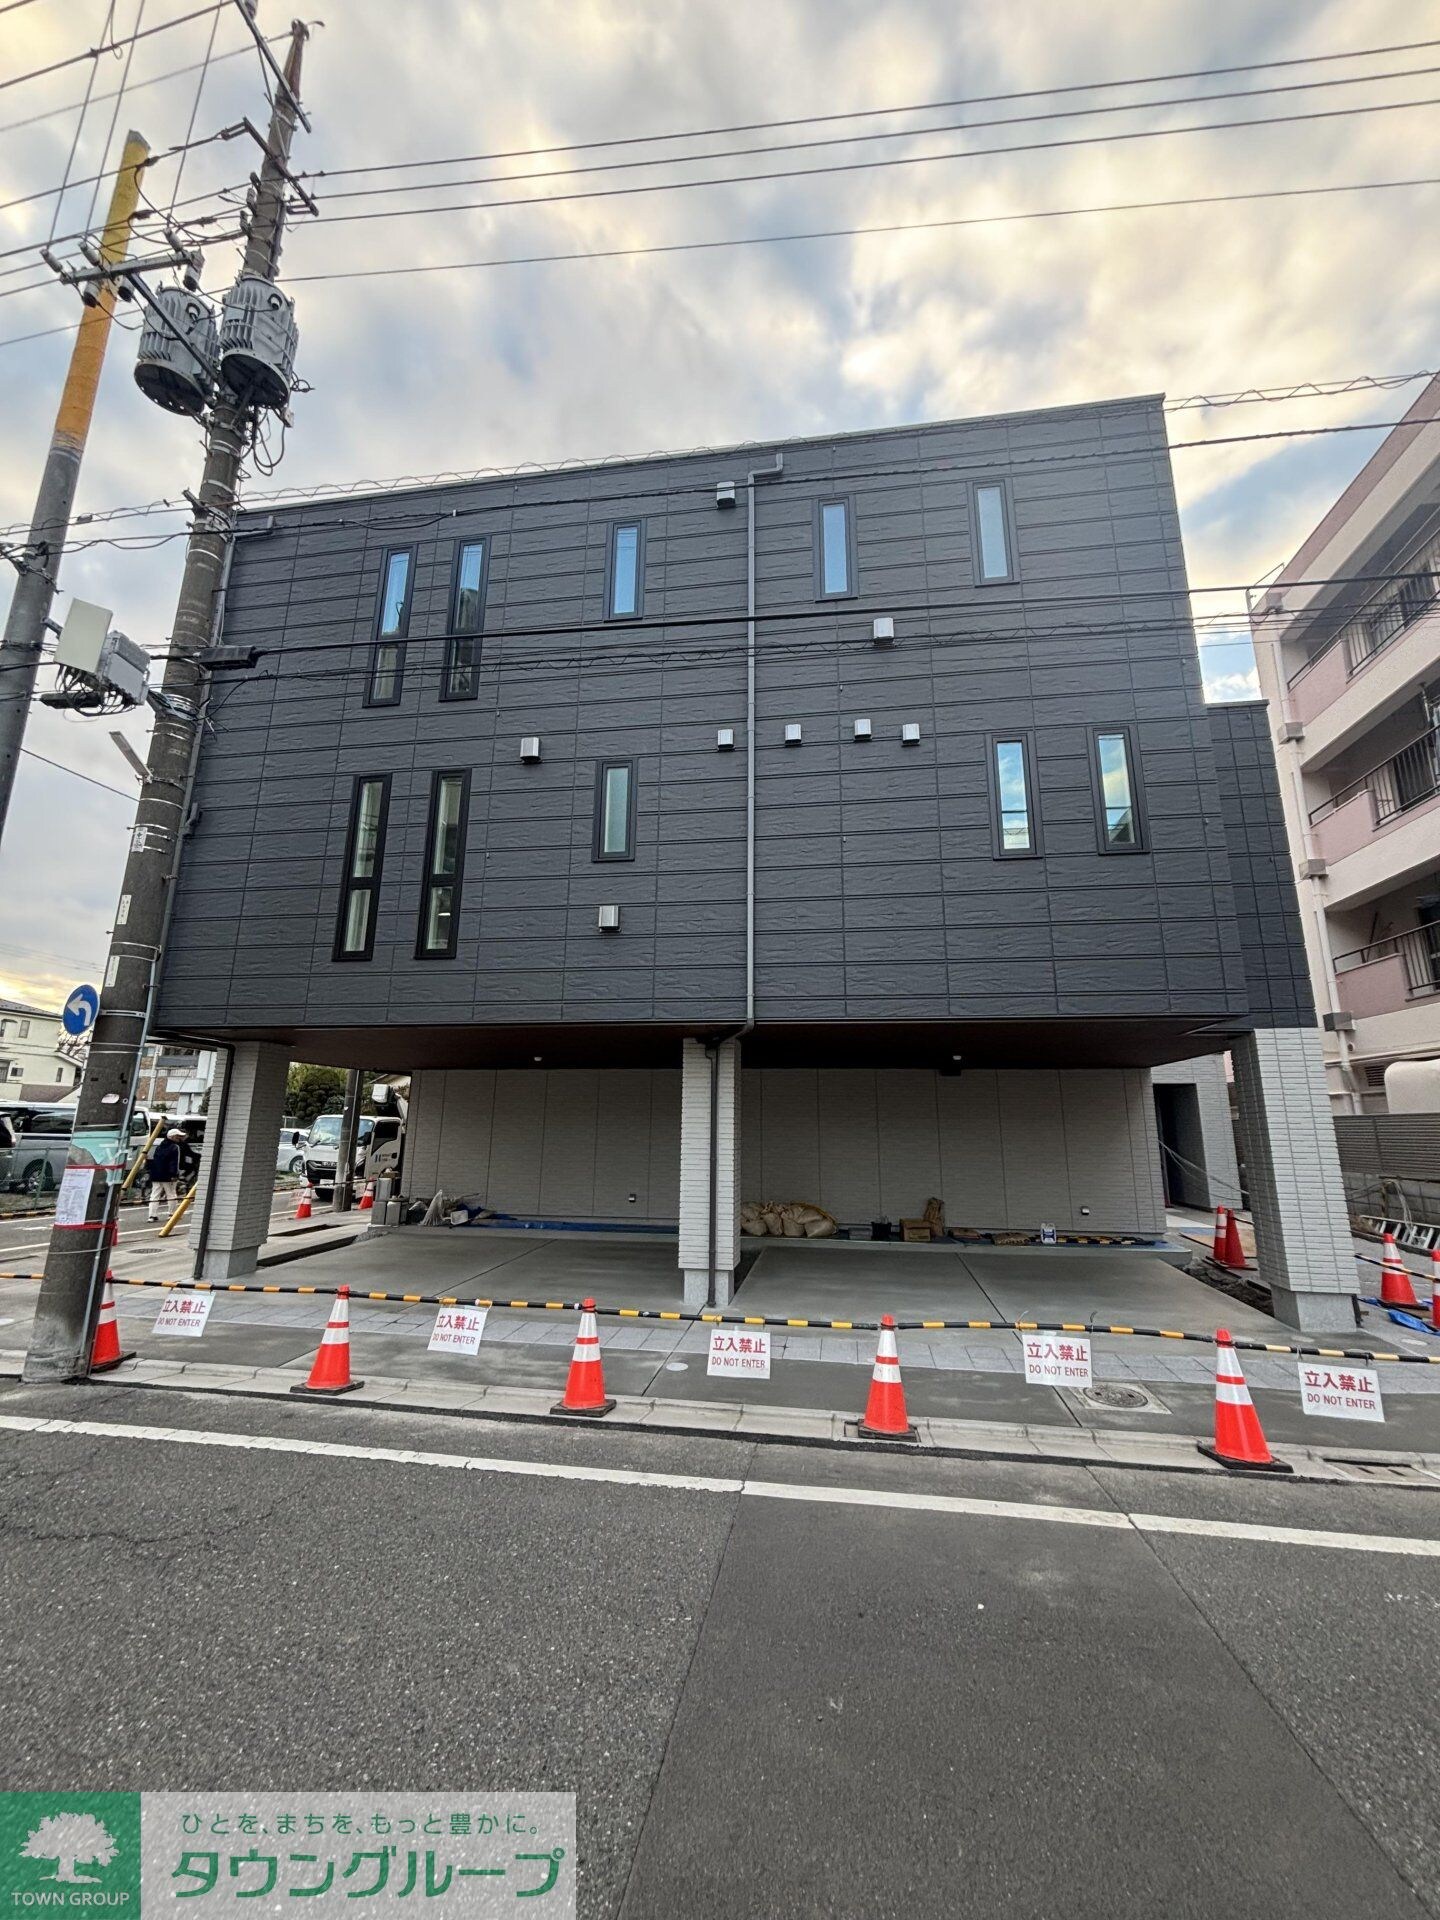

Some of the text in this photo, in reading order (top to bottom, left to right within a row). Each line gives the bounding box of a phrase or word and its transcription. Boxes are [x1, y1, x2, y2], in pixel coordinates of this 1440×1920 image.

[163, 1299, 206, 1314] 立入禁止
[157, 1317, 201, 1327] DO NOT ENTER
[436, 1314, 480, 1331] 立入禁止
[432, 1333, 476, 1344] DO NOT ENTER
[712, 1336, 766, 1353] 立入禁止
[1027, 1342, 1088, 1362] 立入禁止
[711, 1356, 766, 1368] DO NOT ENTER
[1029, 1364, 1089, 1377] DO NOT ENTER
[1304, 1370, 1375, 1393] 立入禁止
[1307, 1393, 1376, 1410] DO NOT ENTER
